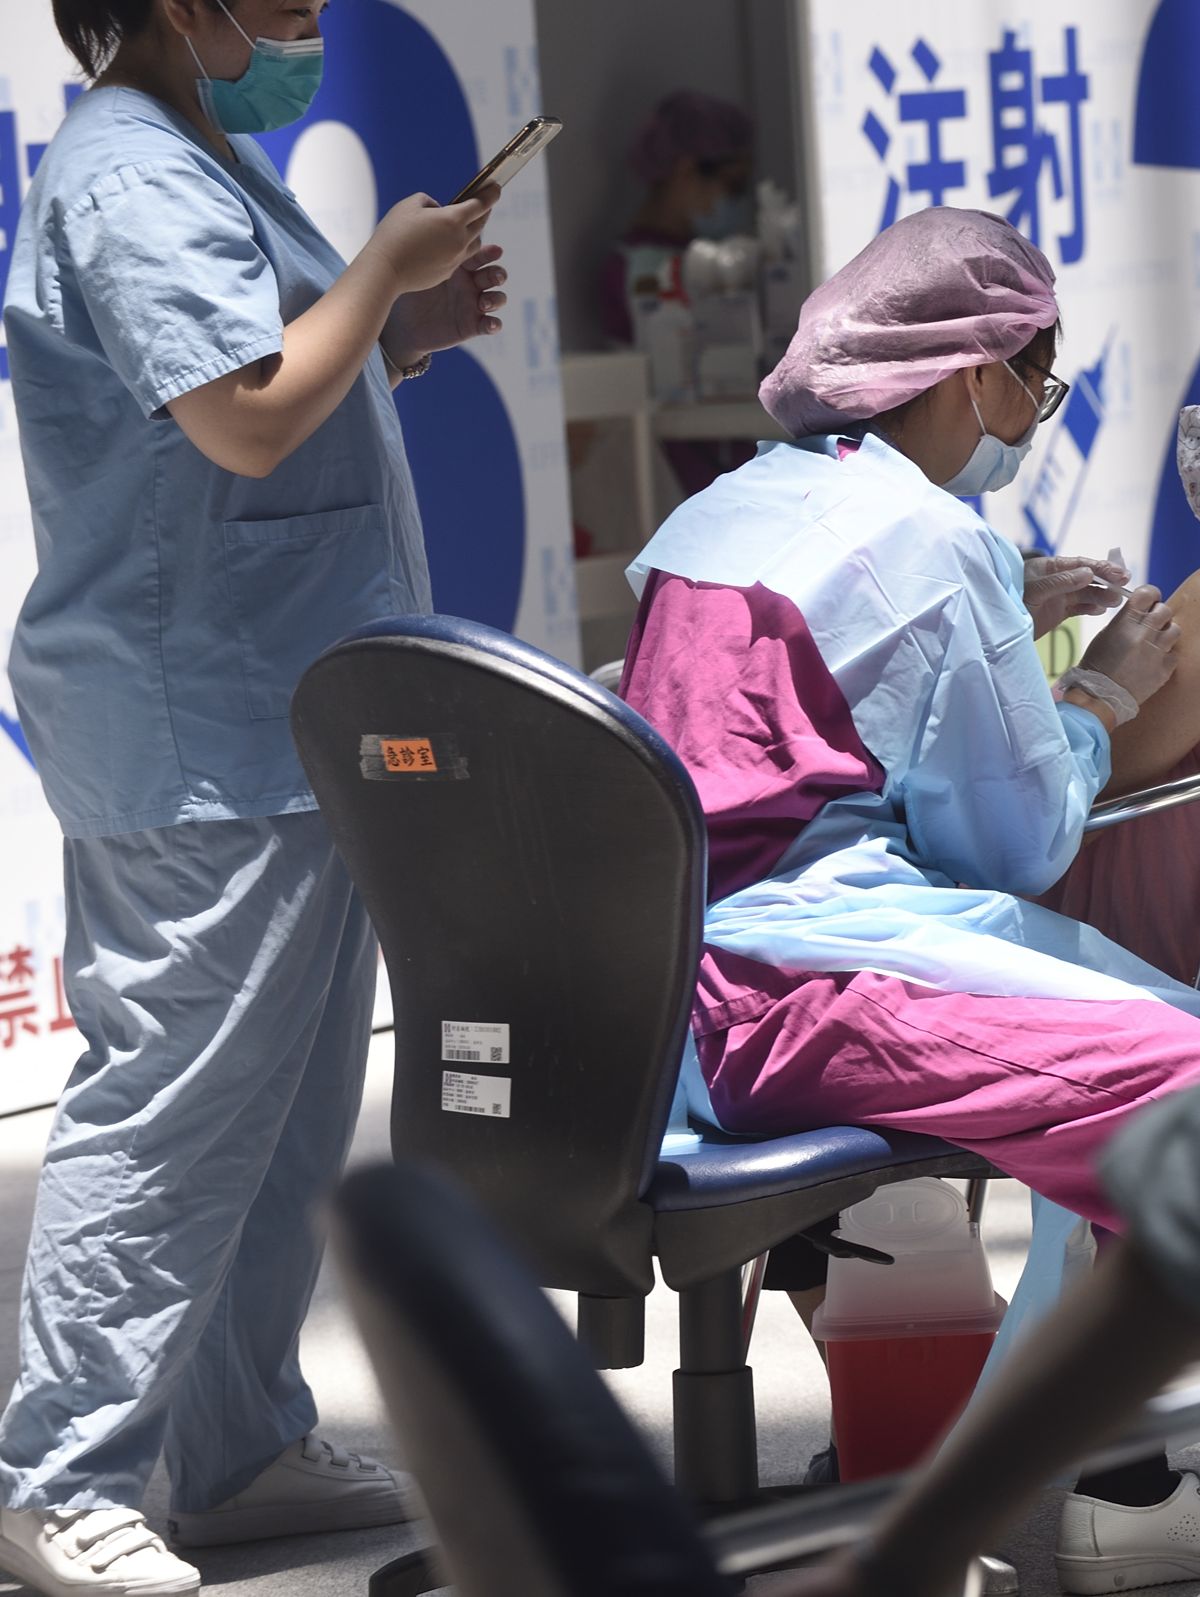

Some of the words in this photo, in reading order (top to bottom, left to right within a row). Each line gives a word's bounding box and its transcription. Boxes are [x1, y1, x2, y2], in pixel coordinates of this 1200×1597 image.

[861, 26, 1091, 264] 注射
[386, 745, 433, 767] 急診室
